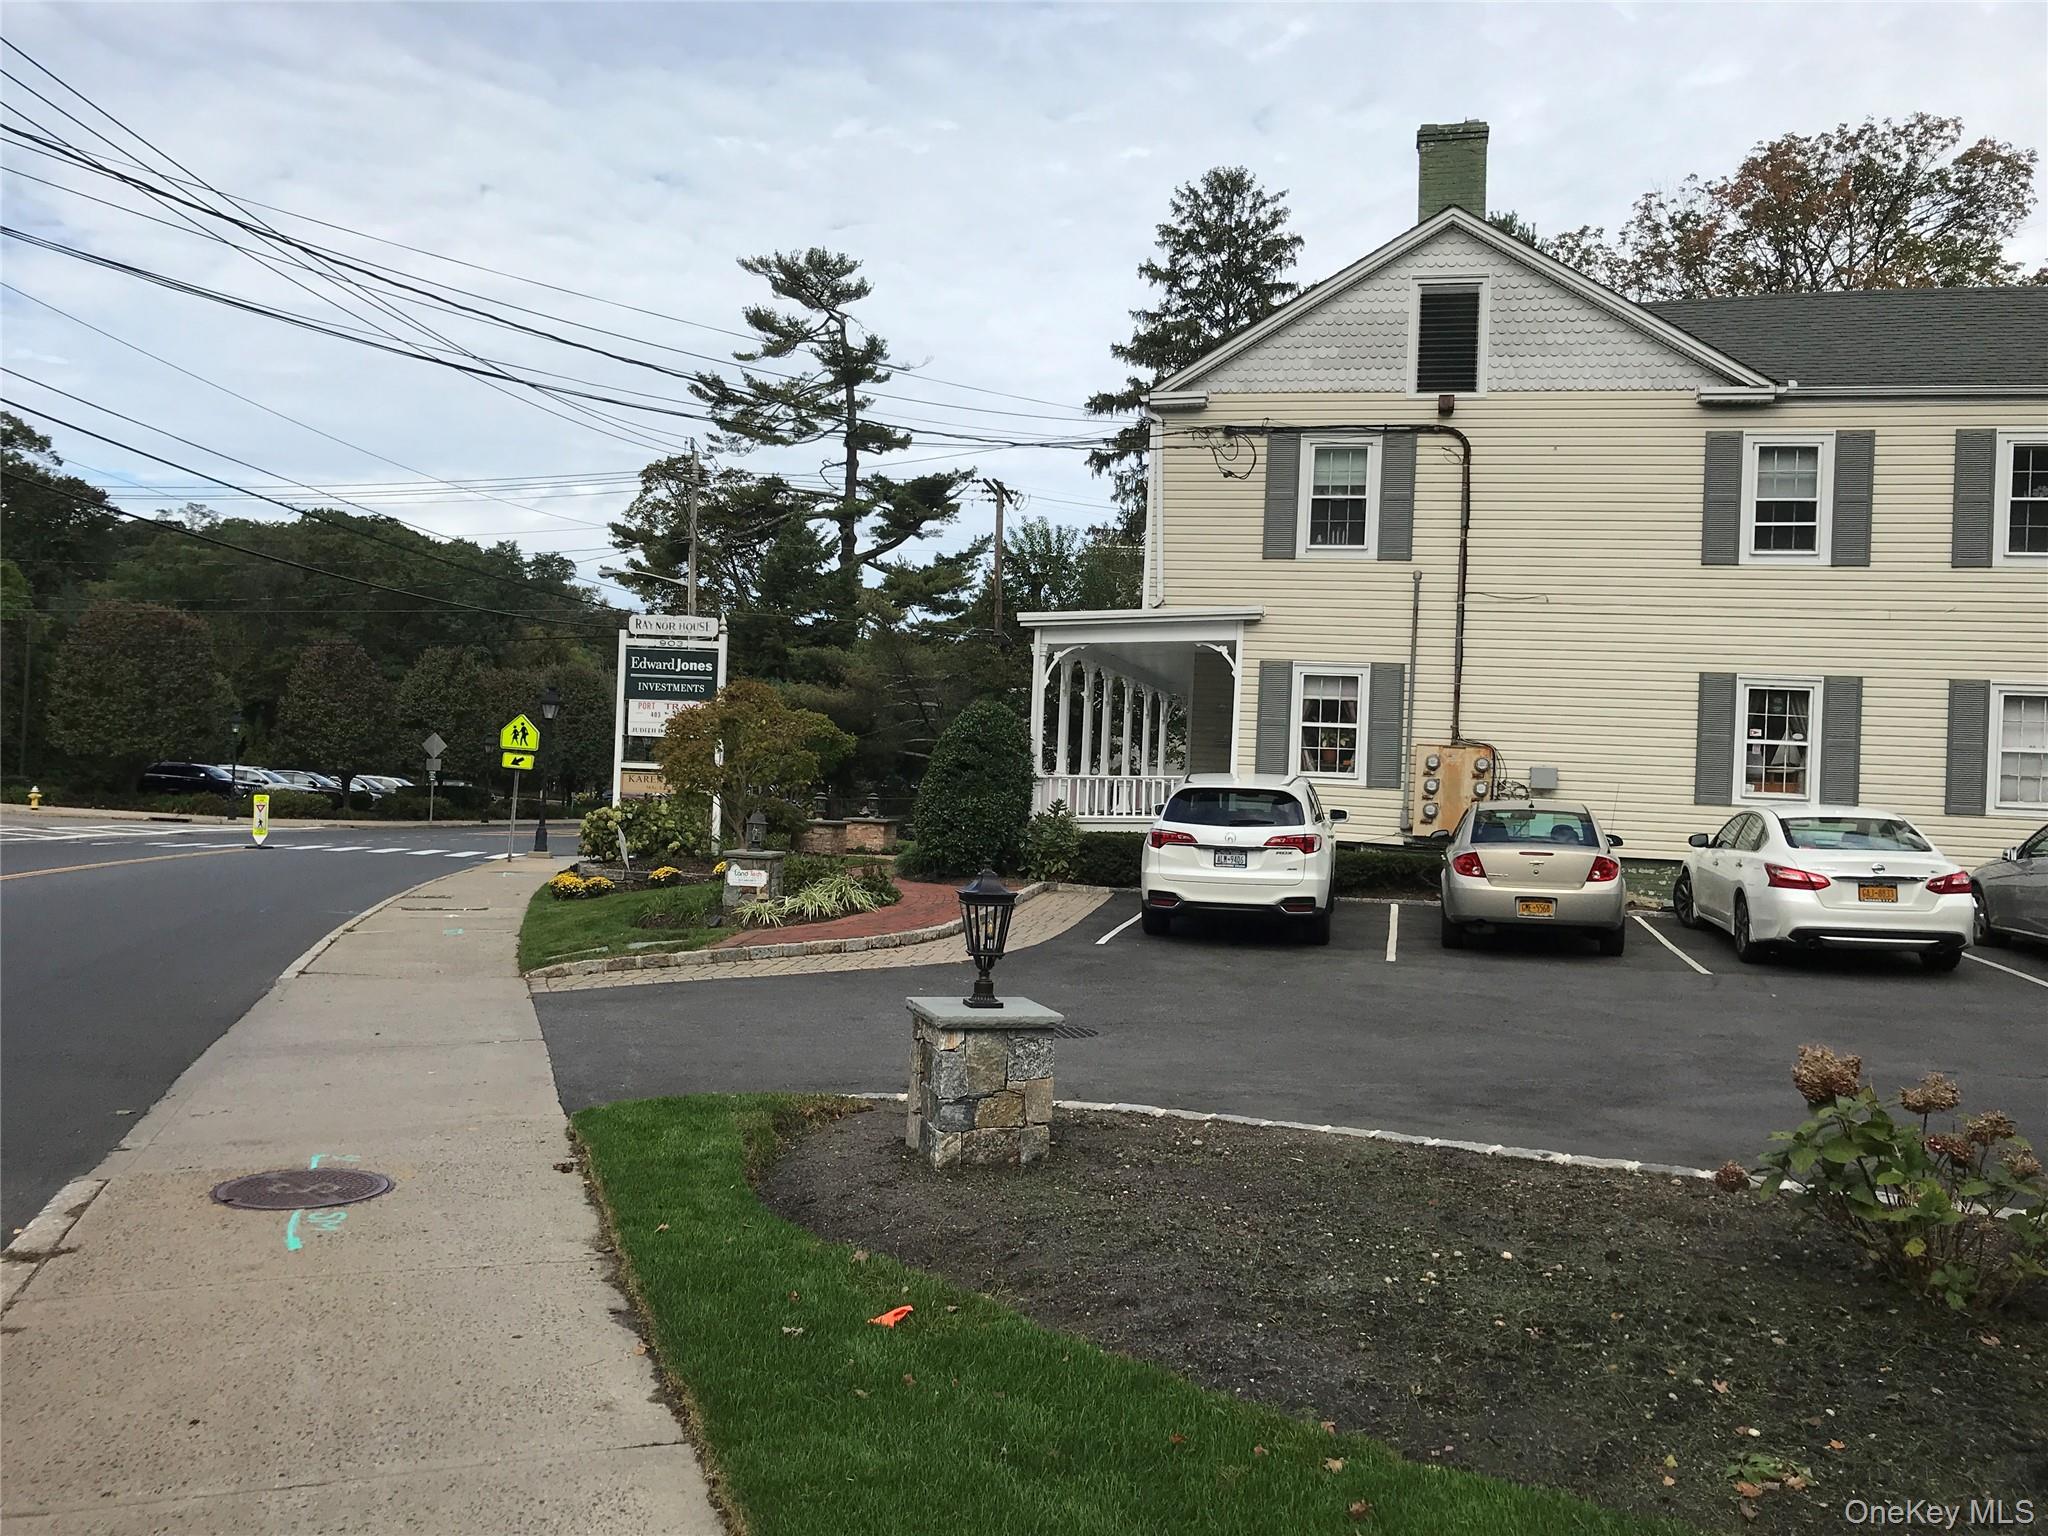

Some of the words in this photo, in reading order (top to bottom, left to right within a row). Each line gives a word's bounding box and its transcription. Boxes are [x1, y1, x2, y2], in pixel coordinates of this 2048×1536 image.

[635, 618, 676, 631] RAYNOR
[659, 639, 683, 648] 903
[631, 656, 675, 671] Edward
[675, 658, 713, 672] Jones
[638, 682, 705, 693] INVESTMENTS
[638, 702, 656, 710] PORT
